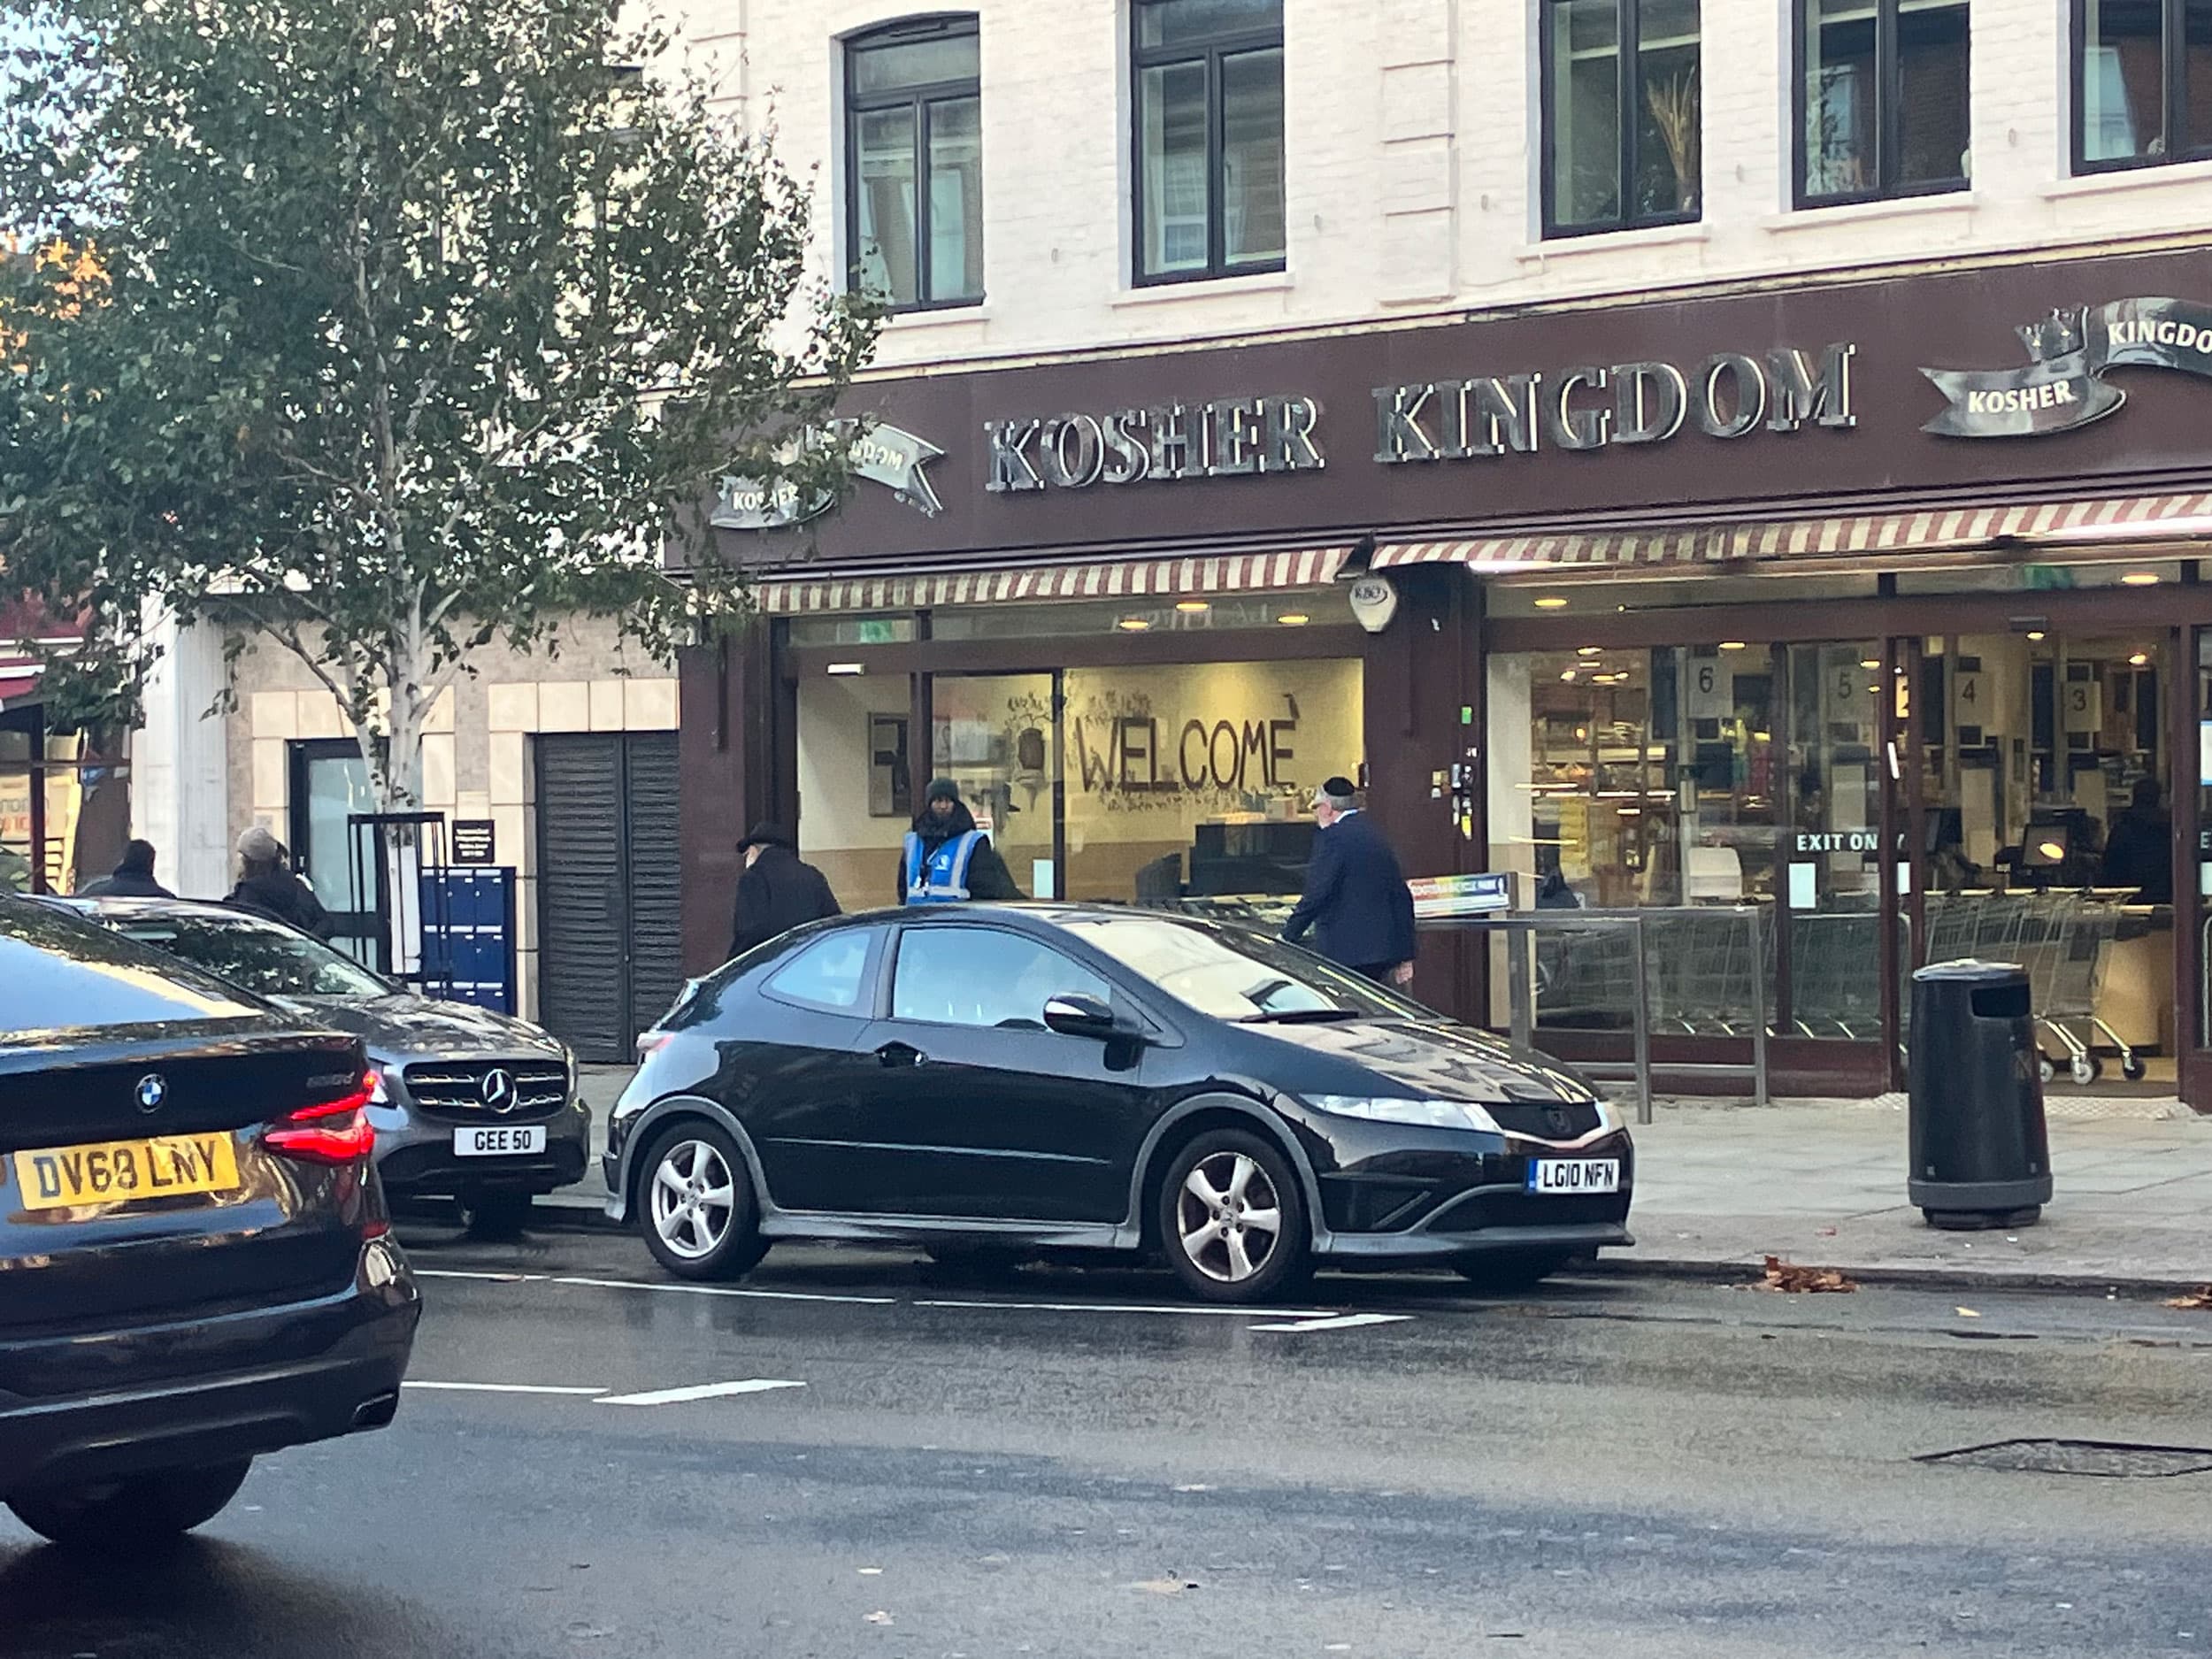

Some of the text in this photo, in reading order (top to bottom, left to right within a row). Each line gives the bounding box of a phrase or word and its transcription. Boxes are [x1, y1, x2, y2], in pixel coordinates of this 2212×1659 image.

[1968, 380, 2076, 413] KOSHER
[984, 341, 1857, 492] KOSHER KINGDOM
[1698, 666, 1714, 694] 6
[1838, 672, 1853, 699] 5
[1962, 677, 1976, 703] 4
[2072, 688, 2087, 712] 3
[1074, 718, 1295, 793] WELCOME
[1797, 833, 1844, 851] EXIT
[474, 1129, 532, 1151] GEE 50
[143, 1139, 216, 1187] LNY
[1543, 1162, 1615, 1188] LG10 NFN
